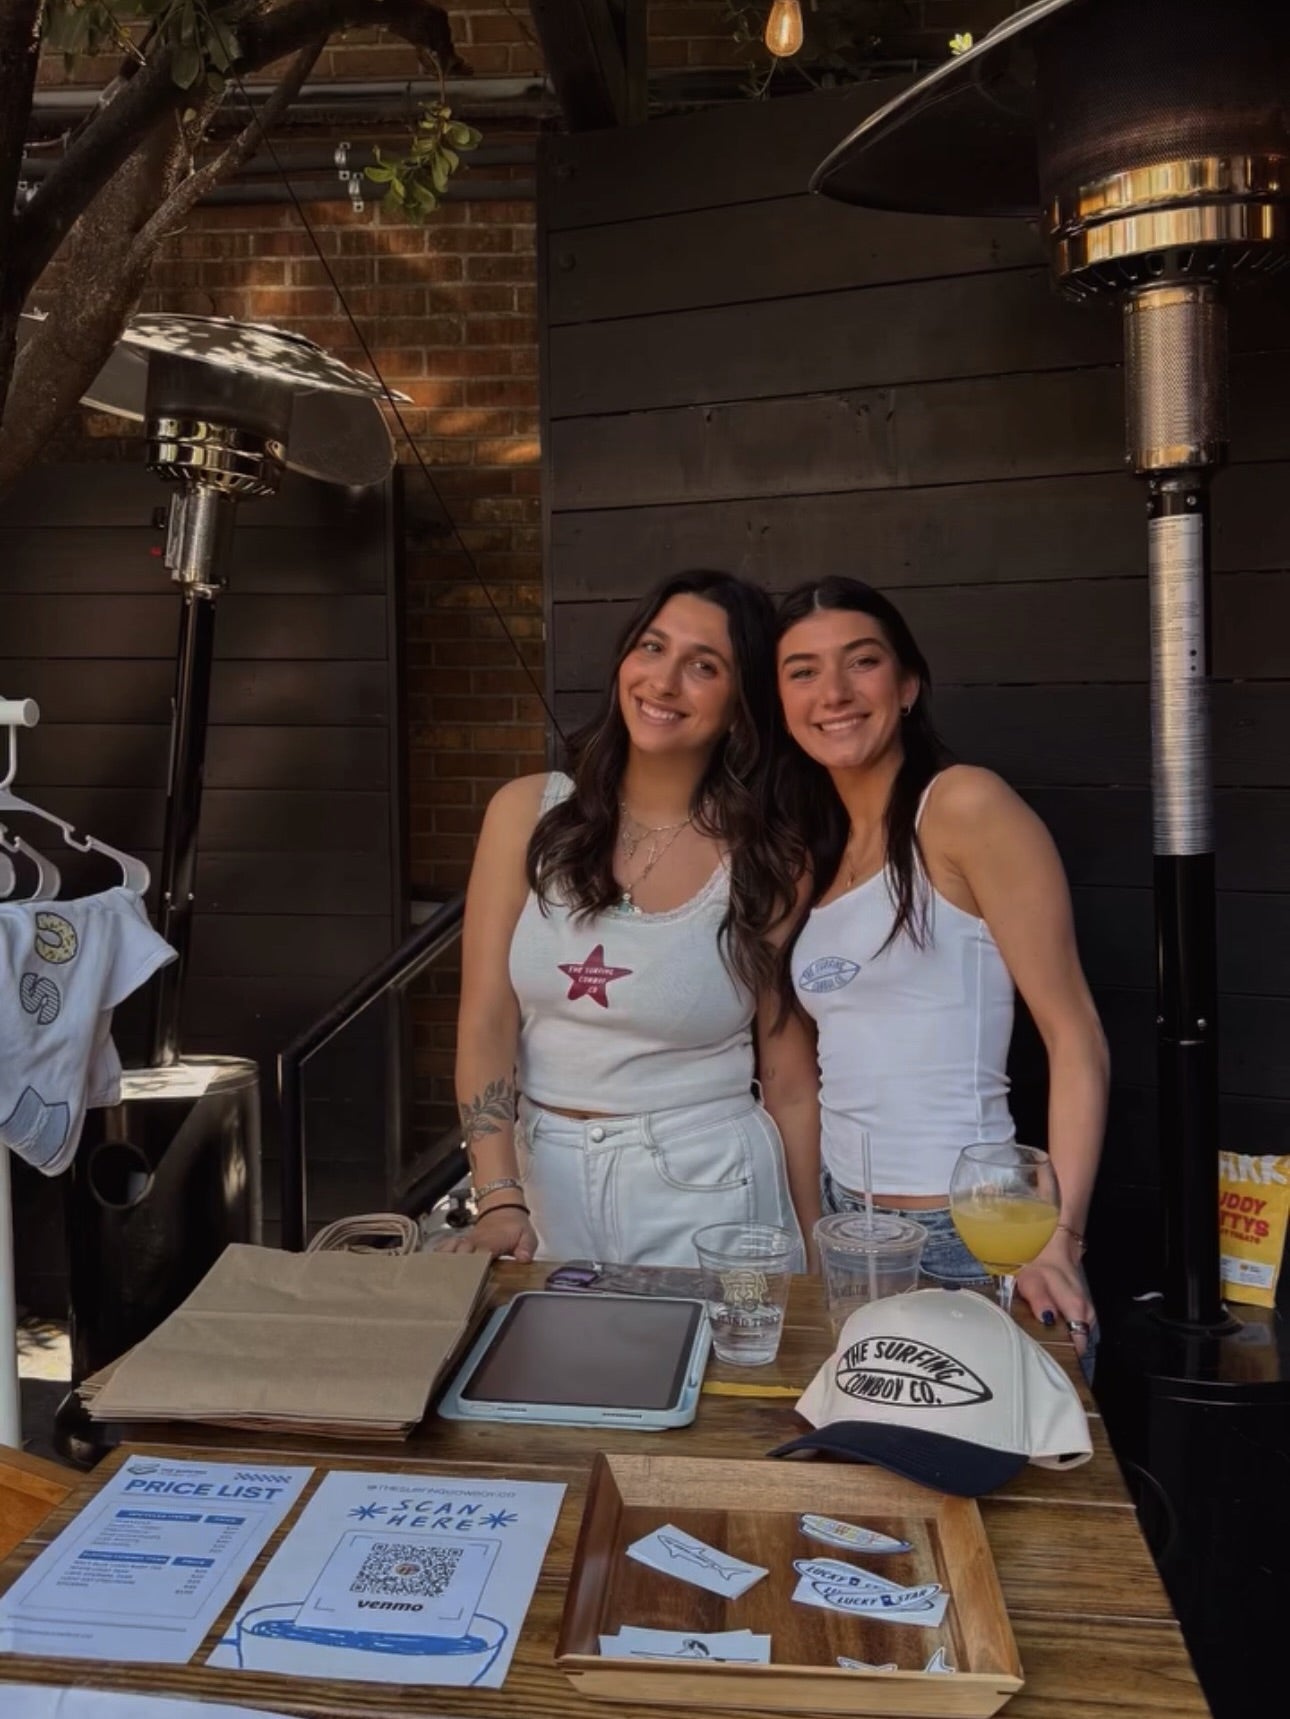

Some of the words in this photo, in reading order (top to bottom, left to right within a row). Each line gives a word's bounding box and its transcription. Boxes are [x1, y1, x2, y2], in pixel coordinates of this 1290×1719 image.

[1218, 1153, 1288, 1185] ARK
[1219, 1191, 1267, 1214] UDDY
[1219, 1209, 1269, 1238] TTYS
[843, 1343, 868, 1369] THE
[874, 1341, 964, 1380] SURFING
[845, 1373, 904, 1401] COWBOY
[909, 1380, 943, 1405] CO.
[124, 1479, 214, 1497] PRICE
[216, 1483, 284, 1501] LIST
[391, 1499, 483, 1516] SCAN
[386, 1514, 474, 1532] HERE
[357, 1600, 423, 1612] venmo
[837, 1597, 879, 1606] LUCKY
